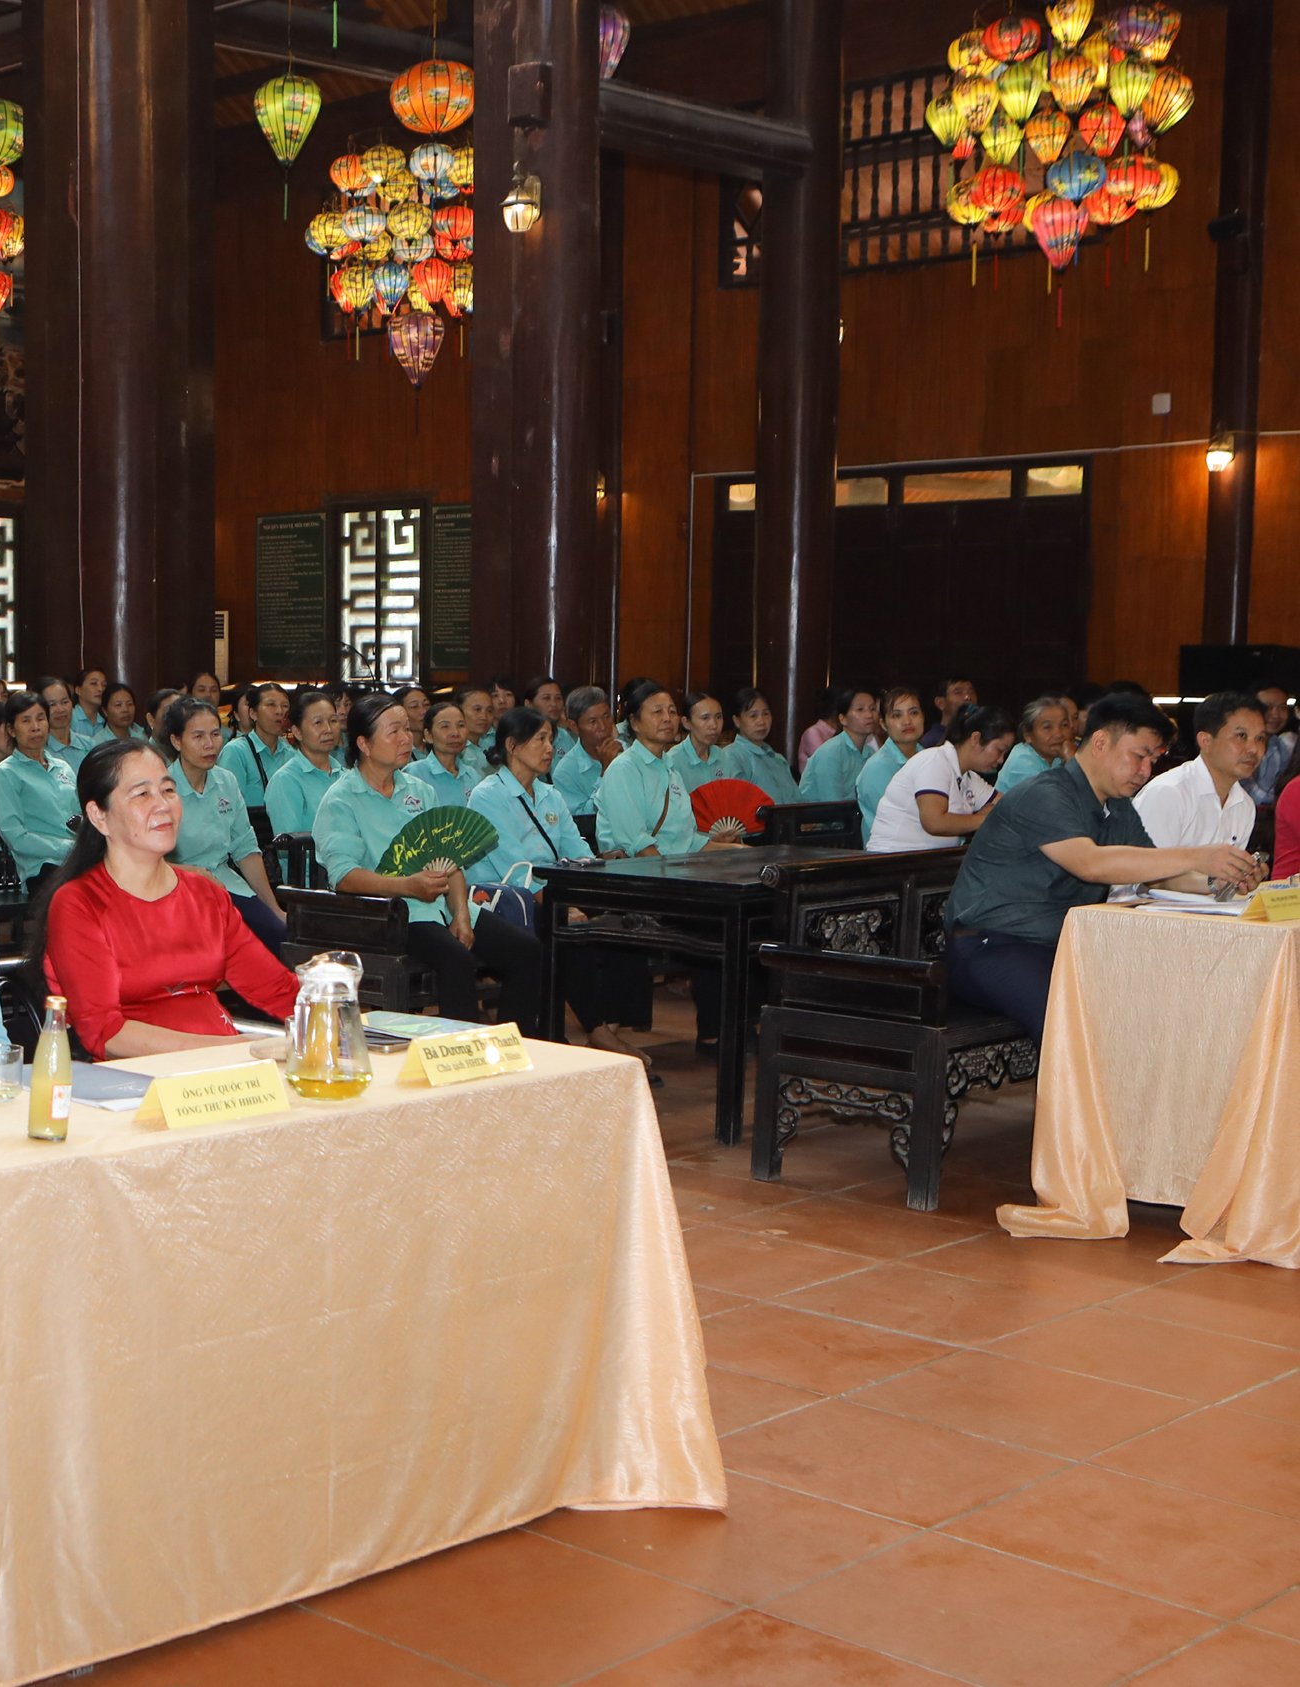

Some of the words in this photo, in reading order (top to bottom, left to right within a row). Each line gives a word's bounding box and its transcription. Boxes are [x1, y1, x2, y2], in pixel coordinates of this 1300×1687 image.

[423, 1046, 439, 1060] Bà
[439, 1043, 473, 1056] Dương
[492, 1034, 520, 1047] Thanh
[182, 1086, 203, 1100] ÔNG
[204, 1083, 217, 1096] VŨ
[218, 1080, 244, 1095] QUỐC
[246, 1077, 261, 1090] TRÍ
[175, 1103, 202, 1117] TỔNG
[204, 1099, 223, 1113] THƯ
[239, 1092, 277, 1107] HHDLVN
